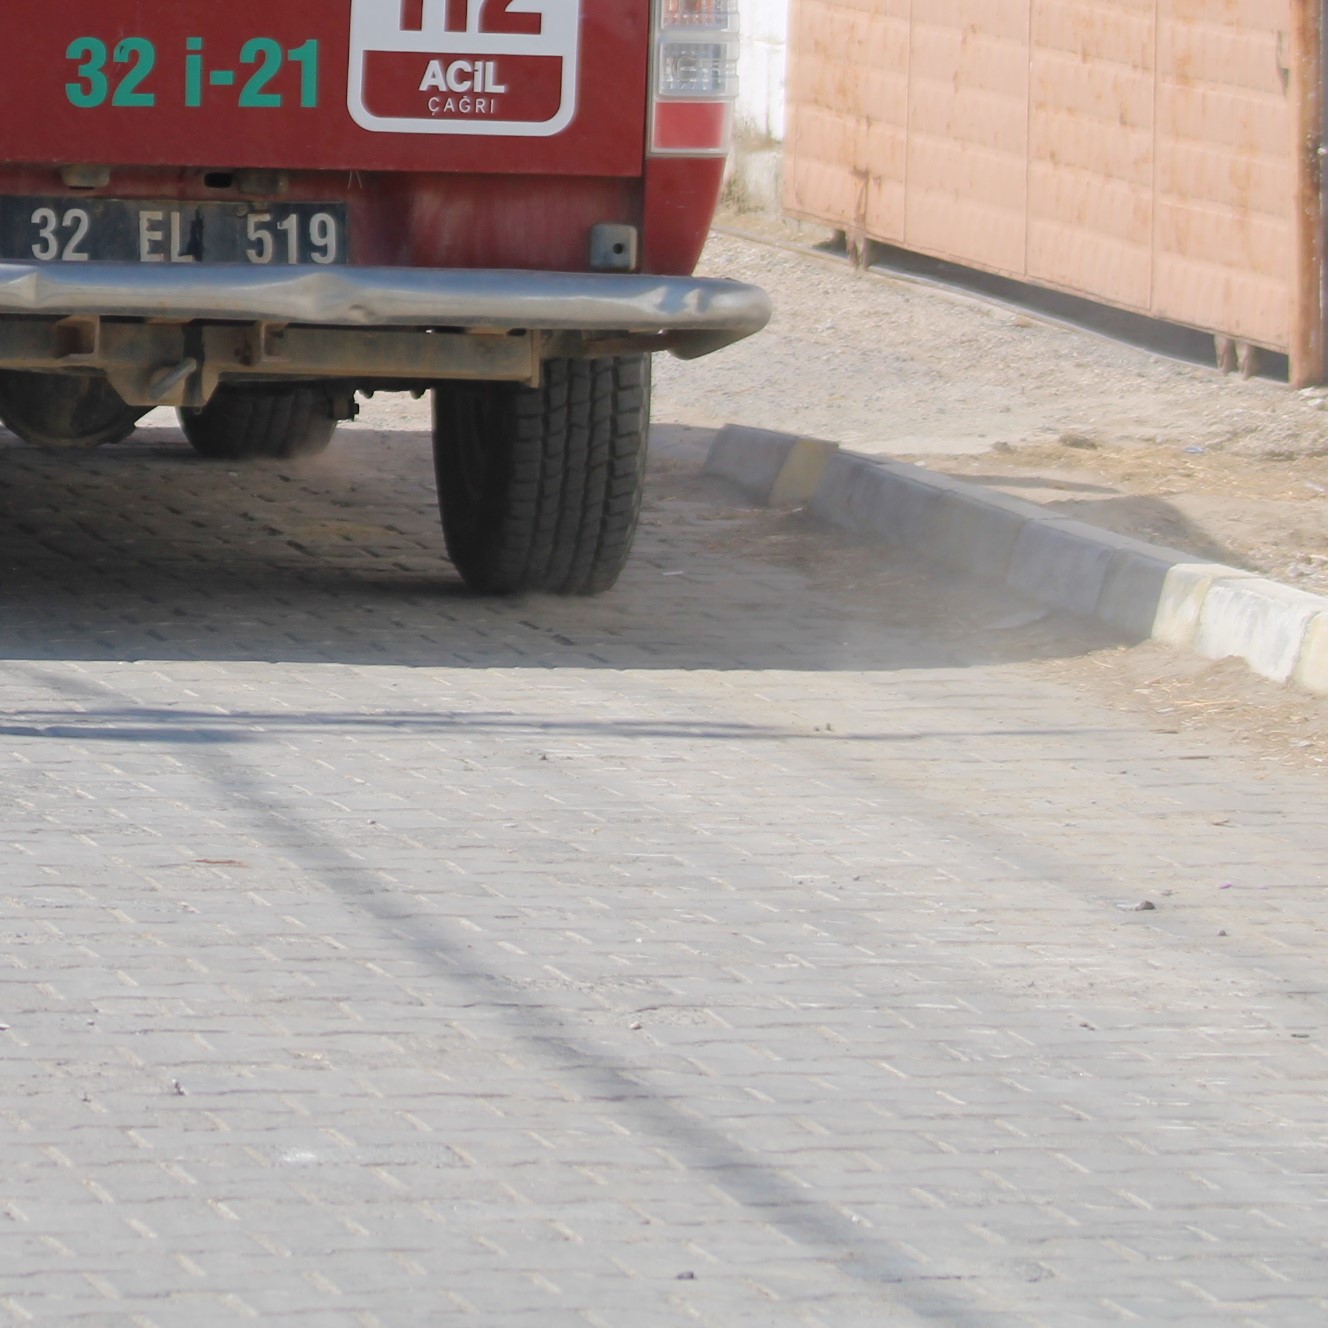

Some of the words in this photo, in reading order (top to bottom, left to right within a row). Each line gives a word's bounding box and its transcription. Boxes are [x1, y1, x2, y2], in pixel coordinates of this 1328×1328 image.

[65, 36, 157, 109] 32
[427, 94, 495, 117] ÇAĞRI
[30, 208, 90, 262] 32
[139, 210, 194, 263] EL
[246, 212, 337, 265] 519
